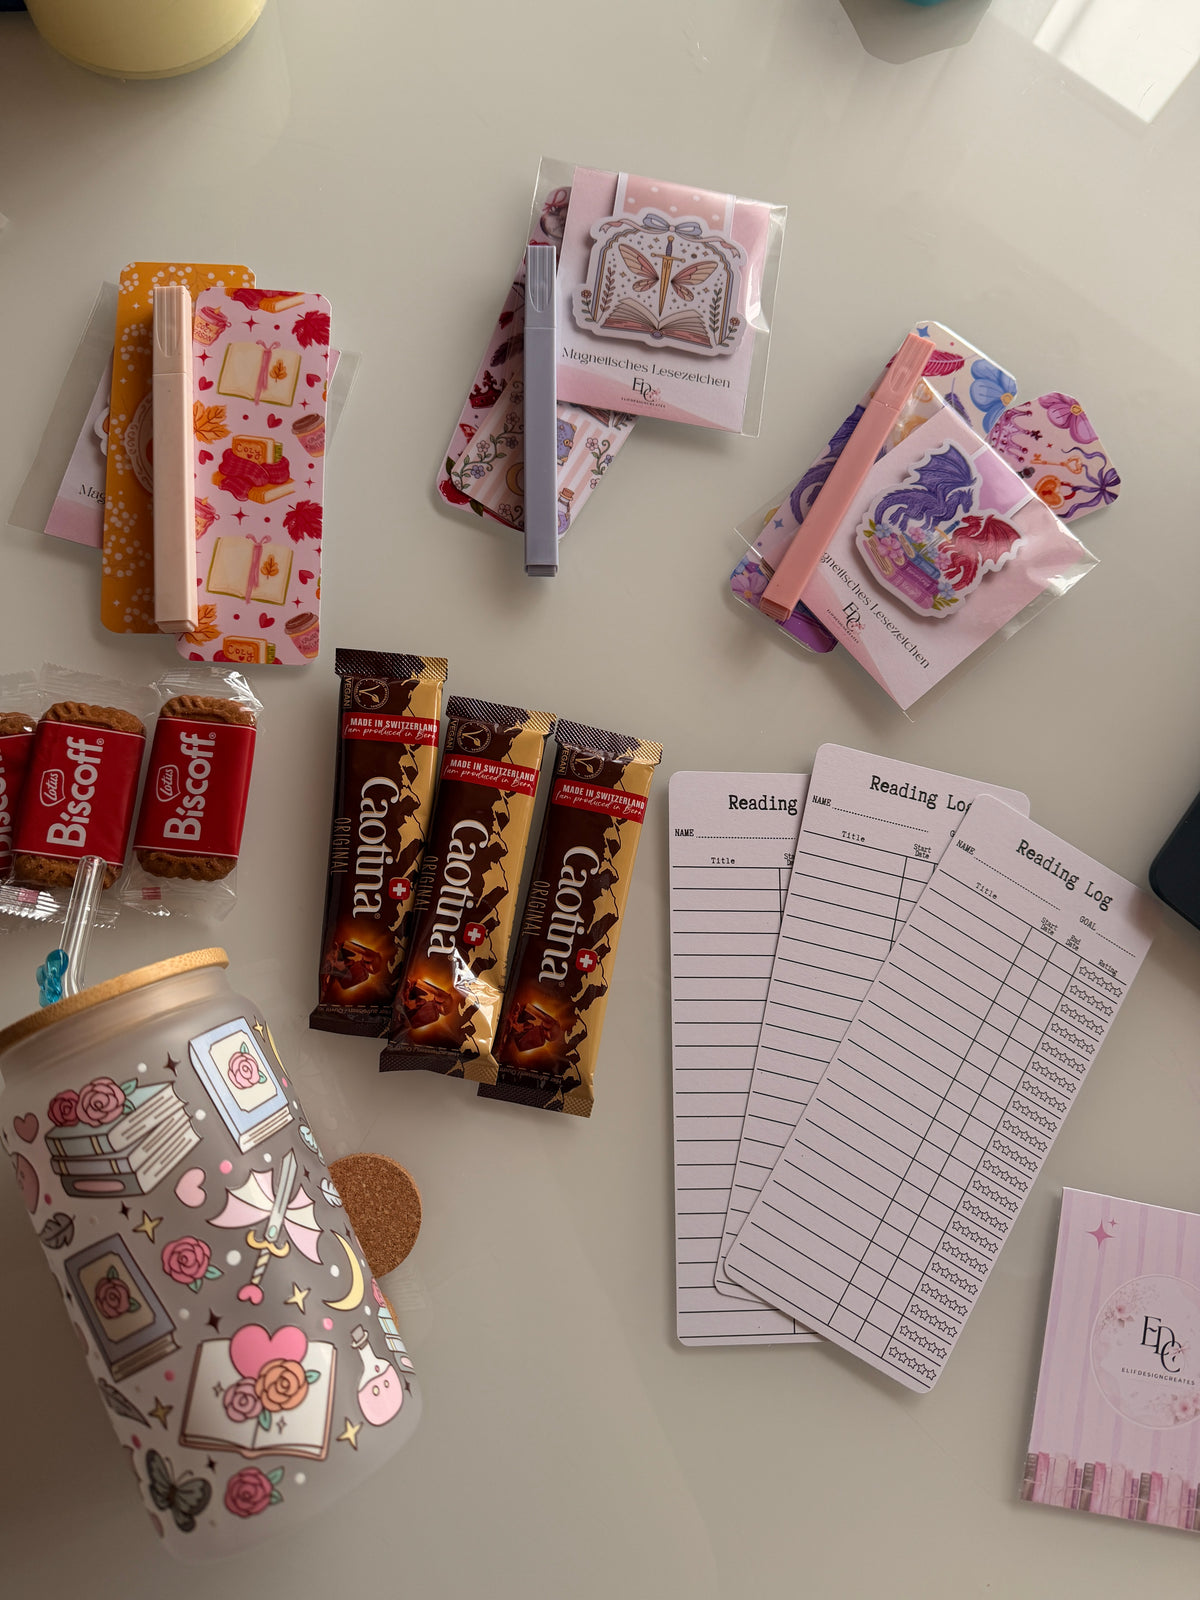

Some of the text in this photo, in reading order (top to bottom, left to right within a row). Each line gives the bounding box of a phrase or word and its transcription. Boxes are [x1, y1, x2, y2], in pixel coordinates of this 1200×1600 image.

[651, 364, 731, 388] Lesezeichen
[820, 552, 871, 605] gnetisches
[870, 603, 930, 669] Lesezeichen
[350, 718, 438, 733] MADE IN SWITZERLAND
[450, 760, 535, 782] MADE IN SWITZERLAND
[43, 773, 59, 801] Lotus
[160, 768, 174, 797] Lotus
[562, 785, 645, 810] MADE IN SWITZERLAND
[811, 795, 832, 807] NAME
[869, 775, 939, 810] Reading
[728, 795, 798, 816] Reading
[674, 829, 695, 837] NAME
[841, 830, 866, 843] Title
[330, 817, 352, 877] ORIGINAL
[913, 843, 932, 854] Start
[914, 850, 930, 860] Date
[956, 839, 976, 855] NAME
[711, 857, 736, 865] Title
[1015, 839, 1114, 912] Reading Log
[975, 882, 998, 900] Title
[1040, 916, 1059, 931] Start
[1040, 923, 1055, 936] Date
[1079, 915, 1097, 932] GOAL
[1065, 939, 1080, 952] Date
[1098, 959, 1119, 977] Rating
[1121, 1367, 1196, 1386] ELIFDESIGNCREATES
